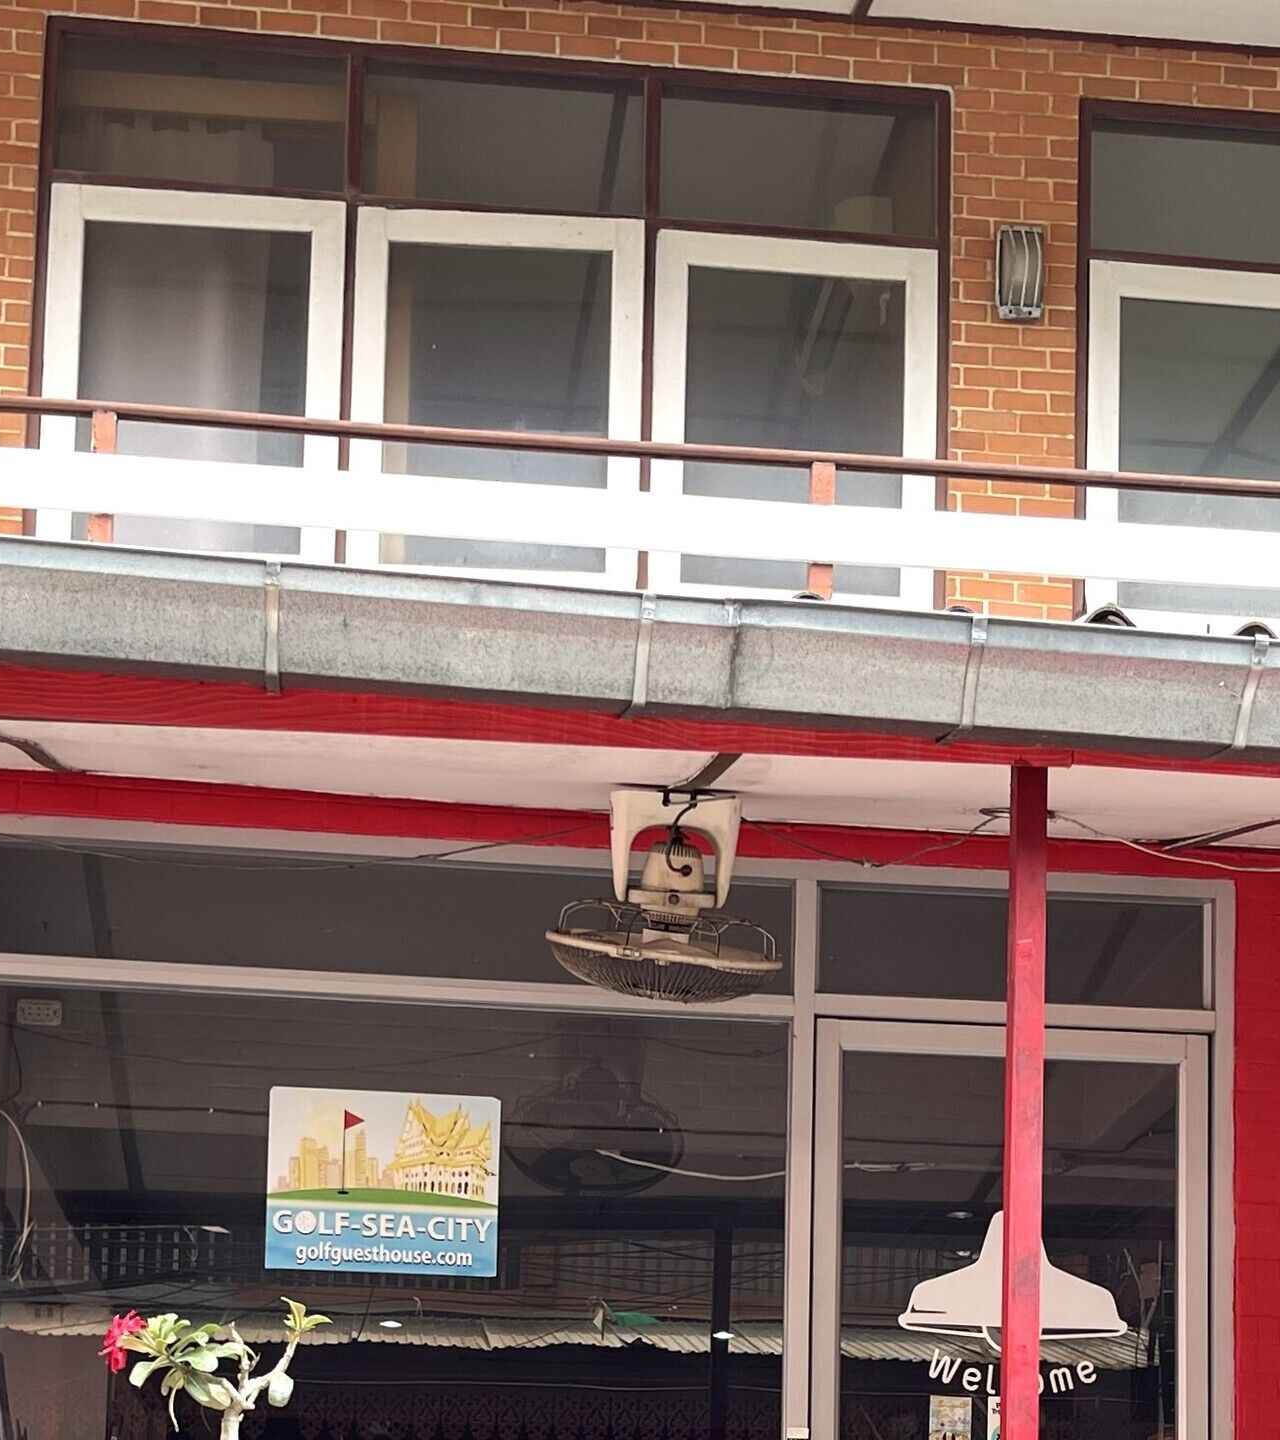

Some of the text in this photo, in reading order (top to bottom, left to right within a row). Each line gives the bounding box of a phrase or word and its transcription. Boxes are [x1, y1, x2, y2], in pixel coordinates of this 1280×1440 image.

[272, 1208, 493, 1243] GOLF-SEA-CITY
[295, 1241, 474, 1267] golfguesthouse.com
[928, 1347, 1098, 1395] Welme
